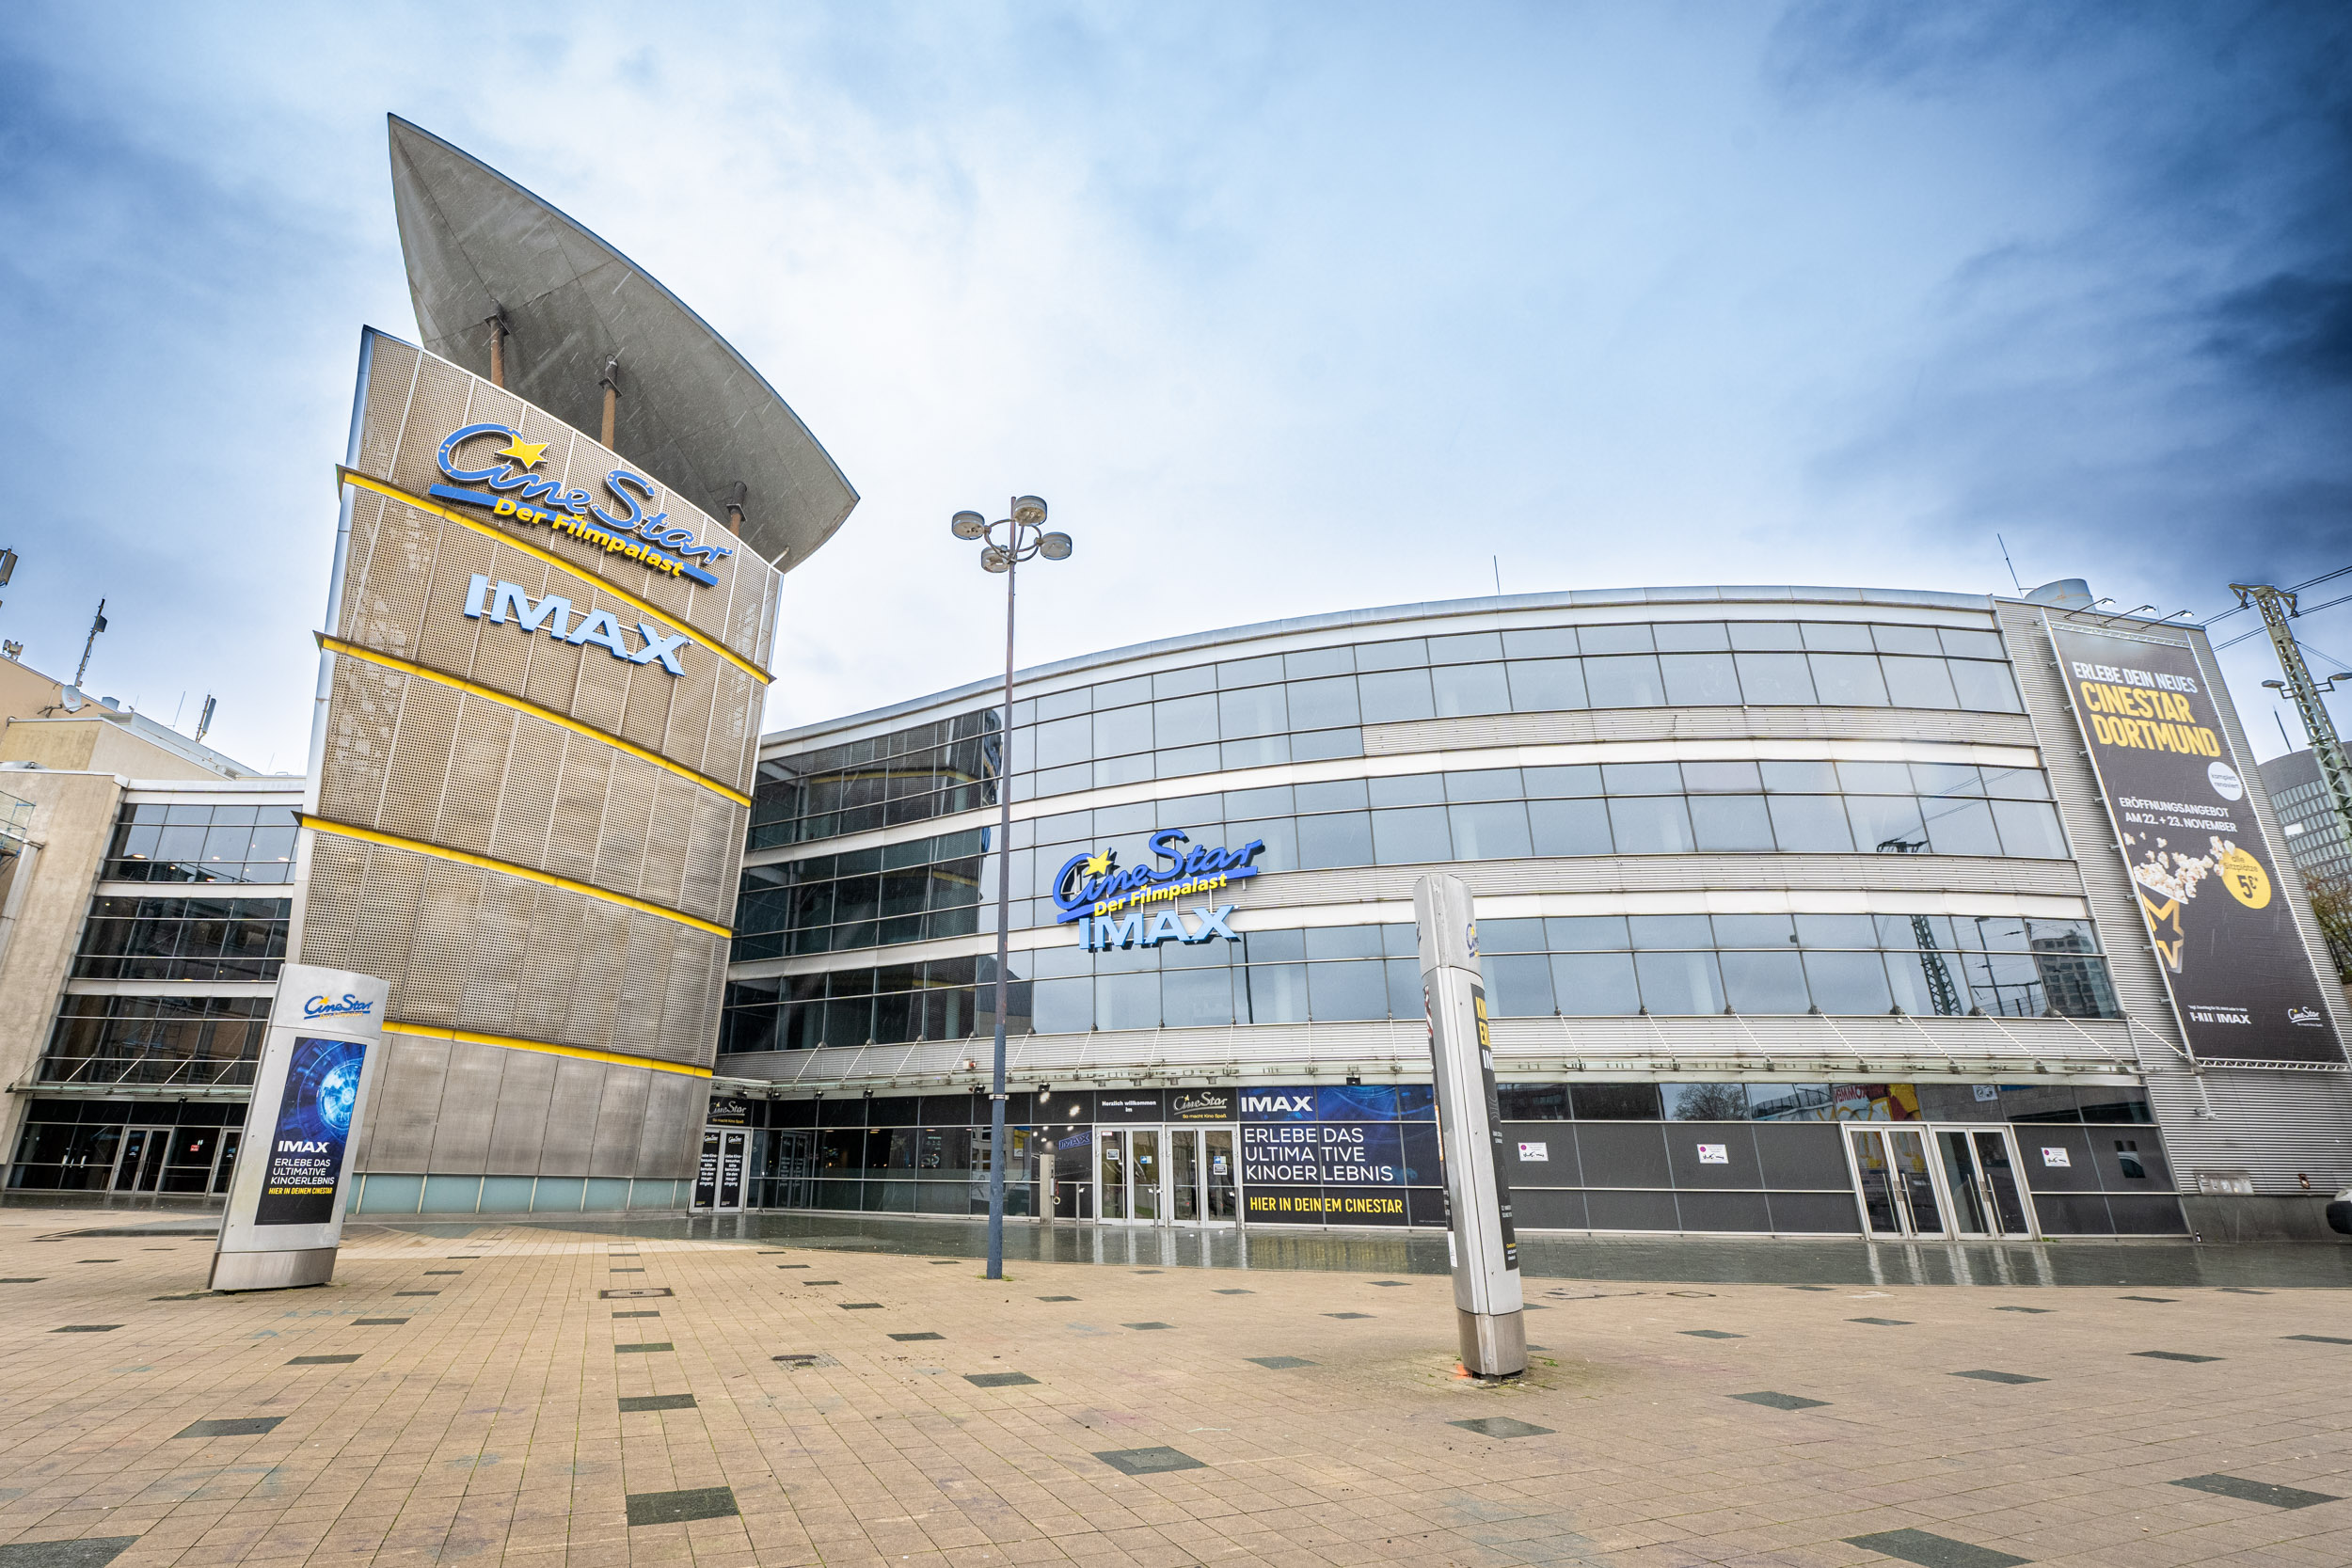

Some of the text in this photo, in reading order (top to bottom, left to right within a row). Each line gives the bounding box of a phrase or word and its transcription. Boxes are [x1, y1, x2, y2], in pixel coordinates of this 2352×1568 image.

[437, 422, 734, 565] CineStar
[493, 498, 685, 578] Der Filmpalast
[464, 574, 687, 677] IMAX
[2072, 661, 2199, 694] ERLEBE DEIN NEUES
[2079, 681, 2197, 724] CINESTAR
[2090, 713, 2221, 758] DORTMUND
[2119, 796, 2230, 818] ERÖFFNUNGSANGEBOT
[2125, 812, 2142, 824] AM
[2142, 813, 2159, 825] 22.
[2168, 816, 2184, 829] 23.
[2184, 817, 2237, 833] NOVEMBER
[1052, 828, 1265, 911] CineStar
[1094, 873, 1228, 917] Der Filmpalast
[1078, 904, 1241, 950] IMAX
[304, 993, 373, 1015] CineStar
[2287, 1006, 2320, 1020] CineStar
[2216, 1013, 2252, 1024] IMAX
[707, 1101, 747, 1115] CineStar
[1172, 1091, 1228, 1111] CineStar
[1241, 1096, 1313, 1113] IMAX
[1244, 1128, 1364, 1143] ERLEBE DAS
[278, 1140, 330, 1153] IMAX
[272, 1167, 326, 1176] ULTIMATIVE
[274, 1158, 331, 1167] ERLEBE DAS
[270, 1177, 335, 1185] KINOERLEBNIS
[1249, 1196, 1277, 1212] HIER
[1279, 1196, 1291, 1212] IN
[1344, 1198, 1404, 1214] CINESTAR
